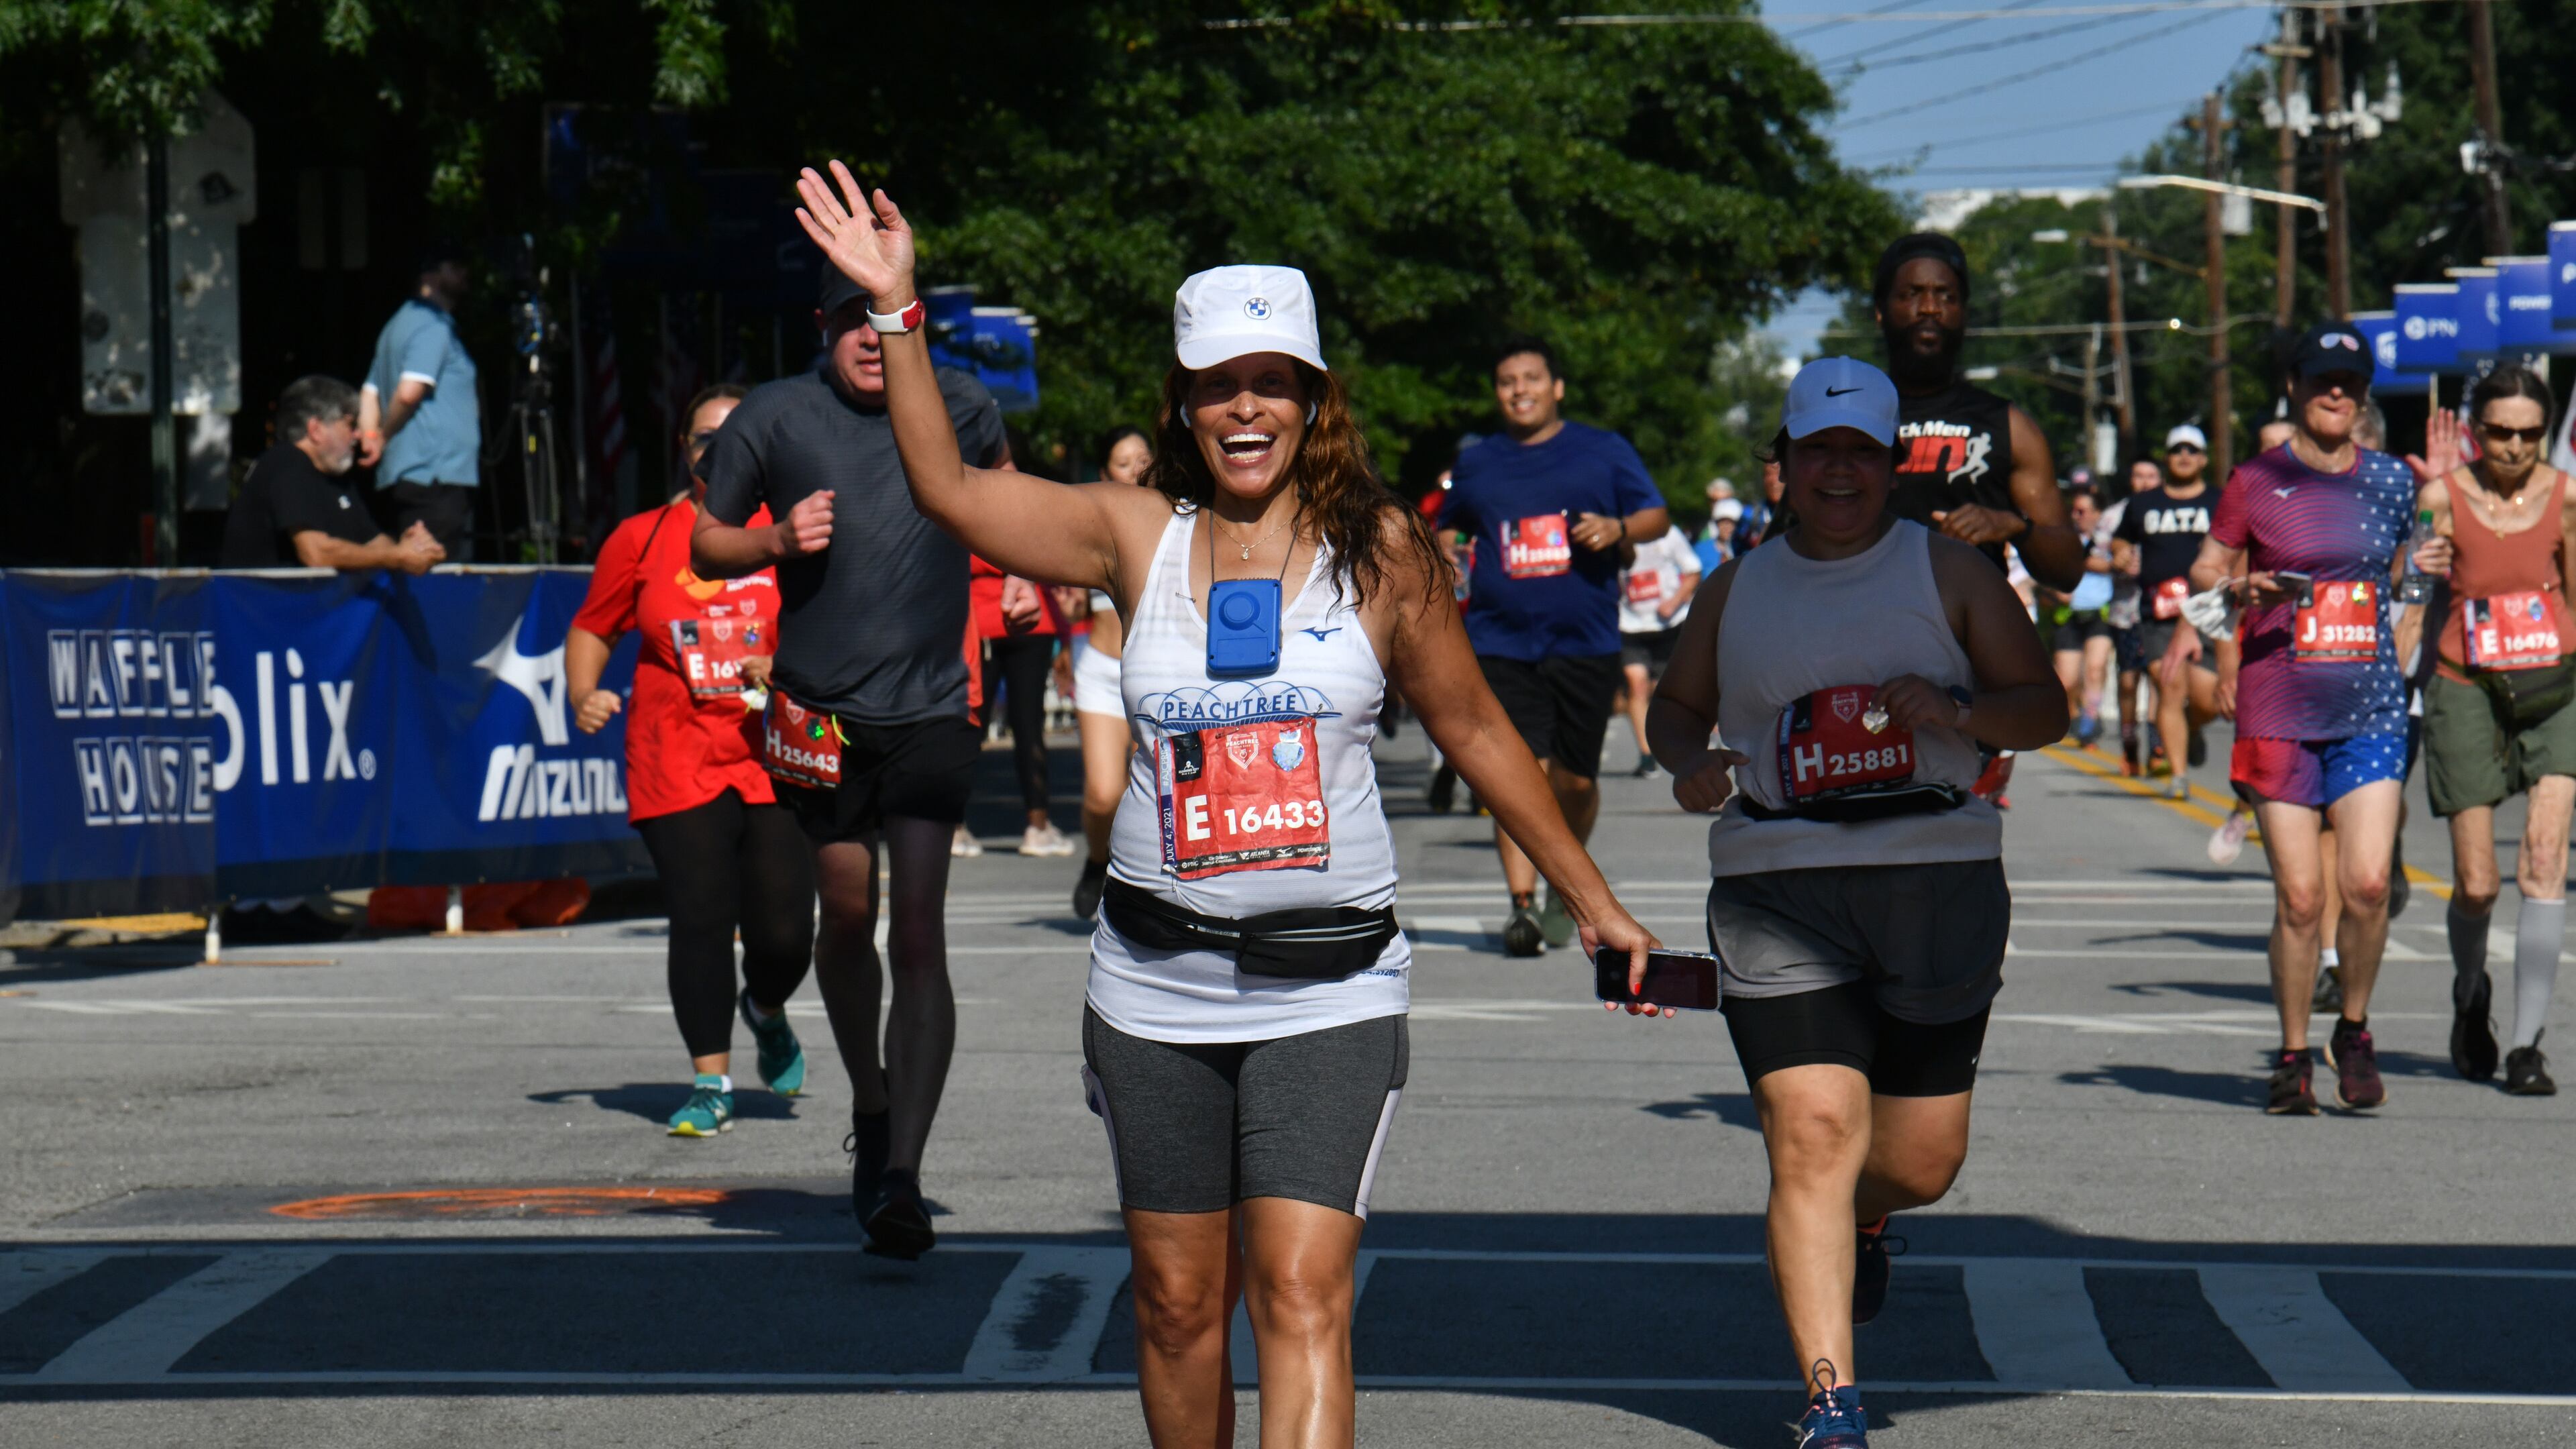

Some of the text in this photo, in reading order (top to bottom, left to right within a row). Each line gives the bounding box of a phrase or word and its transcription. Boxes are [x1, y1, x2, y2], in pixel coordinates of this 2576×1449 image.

[1510, 542, 1528, 564] H
[2302, 616, 2376, 643] J 31282
[2481, 629, 2499, 655] E
[52, 639, 215, 705] WAFFLE
[688, 653, 704, 680] E
[1165, 694, 1297, 720] PEACHTREE
[766, 725, 839, 773] H 25643
[1226, 739, 1258, 747] PEACHTREE
[1794, 743, 1907, 782] H 25881
[79, 745, 211, 813] HOUSE
[1185, 794, 1326, 841] E 16433
[1166, 843, 1174, 861] JULY
